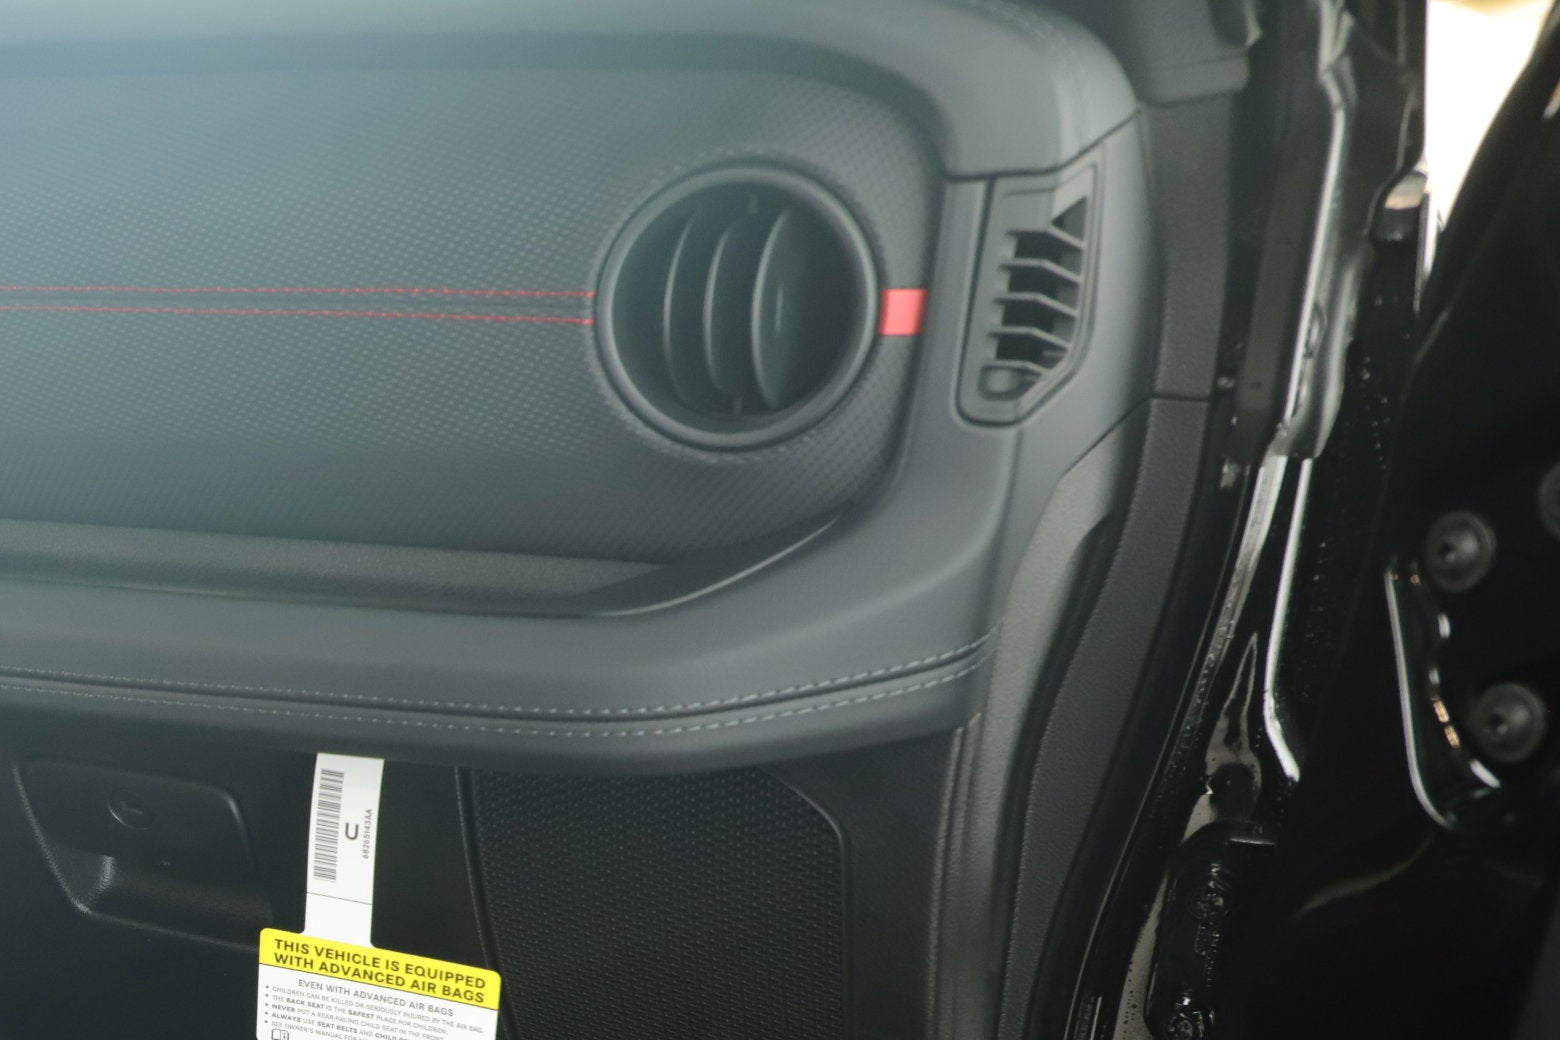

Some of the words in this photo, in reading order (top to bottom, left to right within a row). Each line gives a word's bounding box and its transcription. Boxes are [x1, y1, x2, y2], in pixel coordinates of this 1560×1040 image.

[345, 822, 359, 840] U
[274, 938, 310, 955] THIS
[314, 945, 381, 968] VEHICLE
[385, 959, 400, 972] IS
[405, 963, 486, 989] EQUIPPED
[274, 952, 314, 970] WITH
[319, 961, 406, 987] ADVANCED
[410, 979, 437, 994] AIR
[442, 985, 485, 1004] BAGS
[272, 986, 305, 997] CHILDREN
[306, 992, 320, 1000] CAN
[332, 997, 354, 1007] KILLED
[355, 1001, 364, 1009] OR
[366, 1004, 401, 1016] SERIOUSLY
[403, 1011, 430, 1022] INJURED
[442, 1020, 454, 1028] THE
[272, 994, 284, 1002] THE
[286, 997, 306, 1006] BACK
[307, 1001, 324, 1009] SEAT
[334, 1006, 347, 1014] THE
[348, 1009, 375, 1020] SAFEST
[376, 1014, 397, 1024] PLACE
[298, 979, 323, 990] EVEN
[326, 984, 351, 996] WITH
[353, 990, 407, 1007] ADVANCED
[409, 1001, 425, 1011] AIR
[428, 1004, 454, 1017] BAGS
[272, 1004, 296, 1012] NEVER
[297, 1008, 310, 1016] PUT
[318, 1012, 359, 1026] REAR-FACING
[360, 1020, 380, 1030] CHILD
[382, 1025, 398, 1033] SEAT
[408, 1030, 420, 1038] THE
[272, 1012, 301, 1022] ALWAYS
[303, 1018, 316, 1026] USE
[317, 1021, 335, 1029] SEAT
[336, 1024, 358, 1034] BELTS
[284, 1023, 314, 1034] OWNER'S
[316, 1030, 343, 1040] MANUAL
